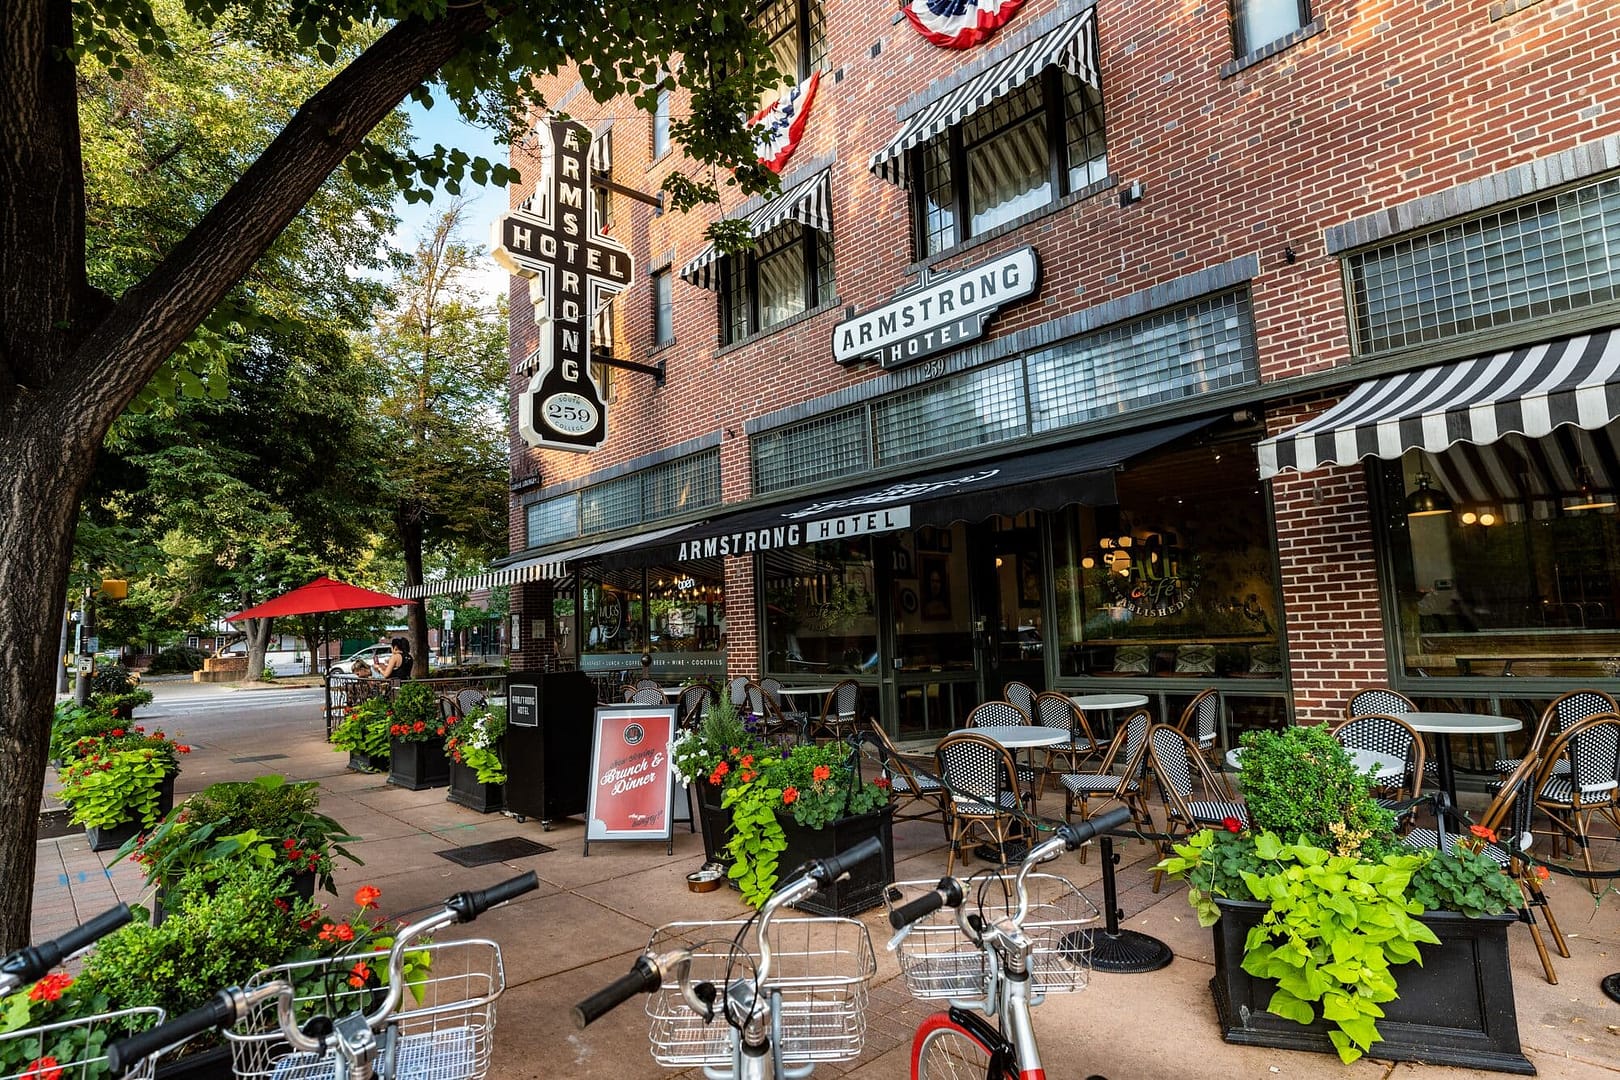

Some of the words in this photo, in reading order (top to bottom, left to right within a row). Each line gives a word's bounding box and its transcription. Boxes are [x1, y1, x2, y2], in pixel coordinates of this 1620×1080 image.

[512, 225, 624, 278] HOTEL
[559, 128, 582, 383] ARMSTRONG
[842, 263, 1019, 352] ARMSTRONG
[891, 321, 970, 362] HOTEL
[924, 359, 945, 378] 259
[549, 404, 590, 423] 259
[558, 397, 581, 405] SOUTH
[555, 421, 584, 431] COLLEGE
[678, 524, 800, 561] ARMSTRONG
[820, 511, 895, 537] HOTEL
[1107, 579, 1184, 617] ESTABLISHED
[1131, 577, 1176, 604] café
[600, 757, 648, 785] Brunch
[651, 752, 665, 768] &
[611, 771, 656, 796] Dinner
